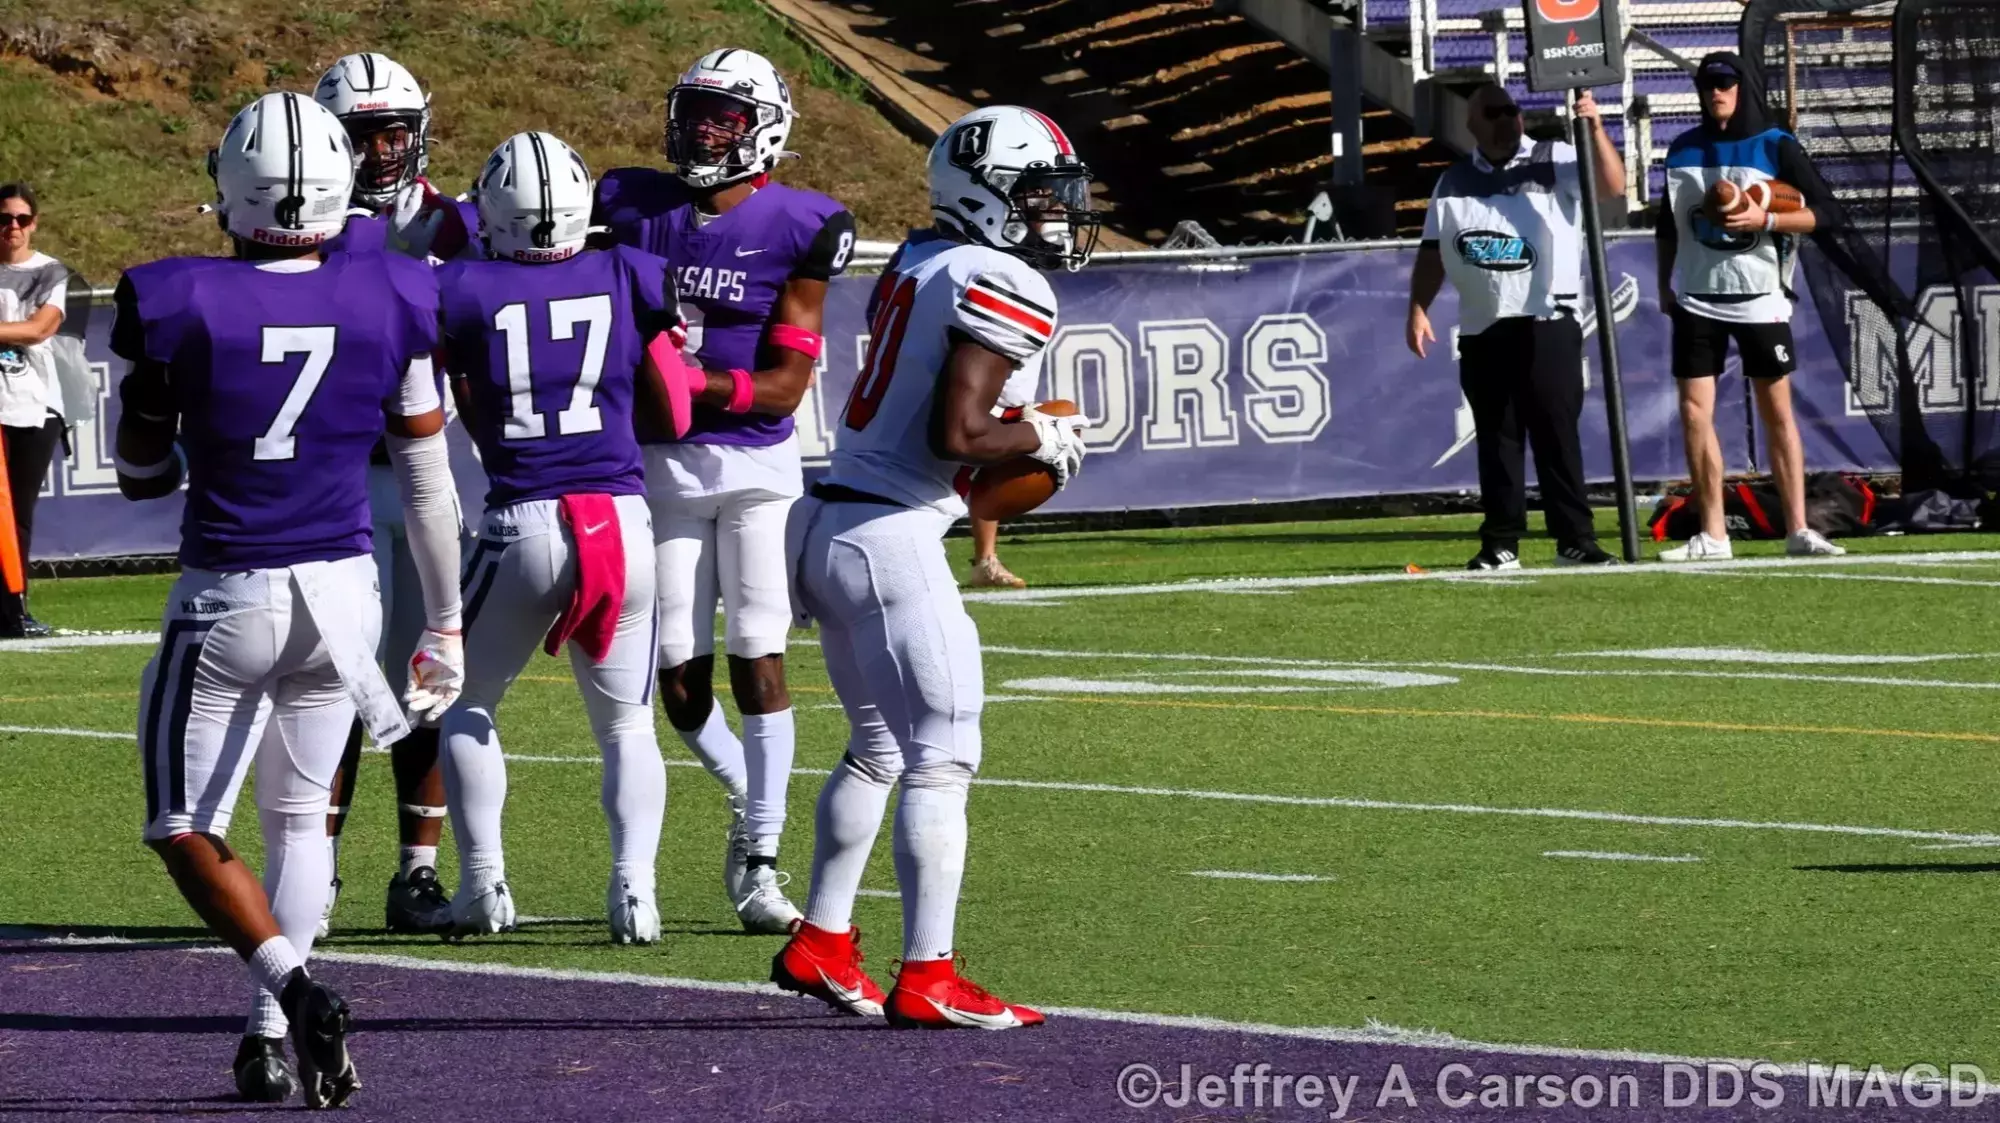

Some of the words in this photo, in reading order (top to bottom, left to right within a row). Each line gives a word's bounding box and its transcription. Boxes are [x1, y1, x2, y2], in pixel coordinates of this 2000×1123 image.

[1543, 47, 1567, 59] BSN
[1567, 42, 1604, 56] SPORTS
[695, 77, 723, 86] Riddell
[356, 102, 388, 110] Riddell
[957, 126, 982, 155] R
[253, 228, 326, 245] Riddell
[514, 247, 573, 261] Riddell
[833, 231, 853, 268] 8
[494, 293, 613, 440] 17
[252, 325, 337, 461] 7
[488, 524, 519, 537] MAJORS
[181, 600, 229, 615] MAJORS
